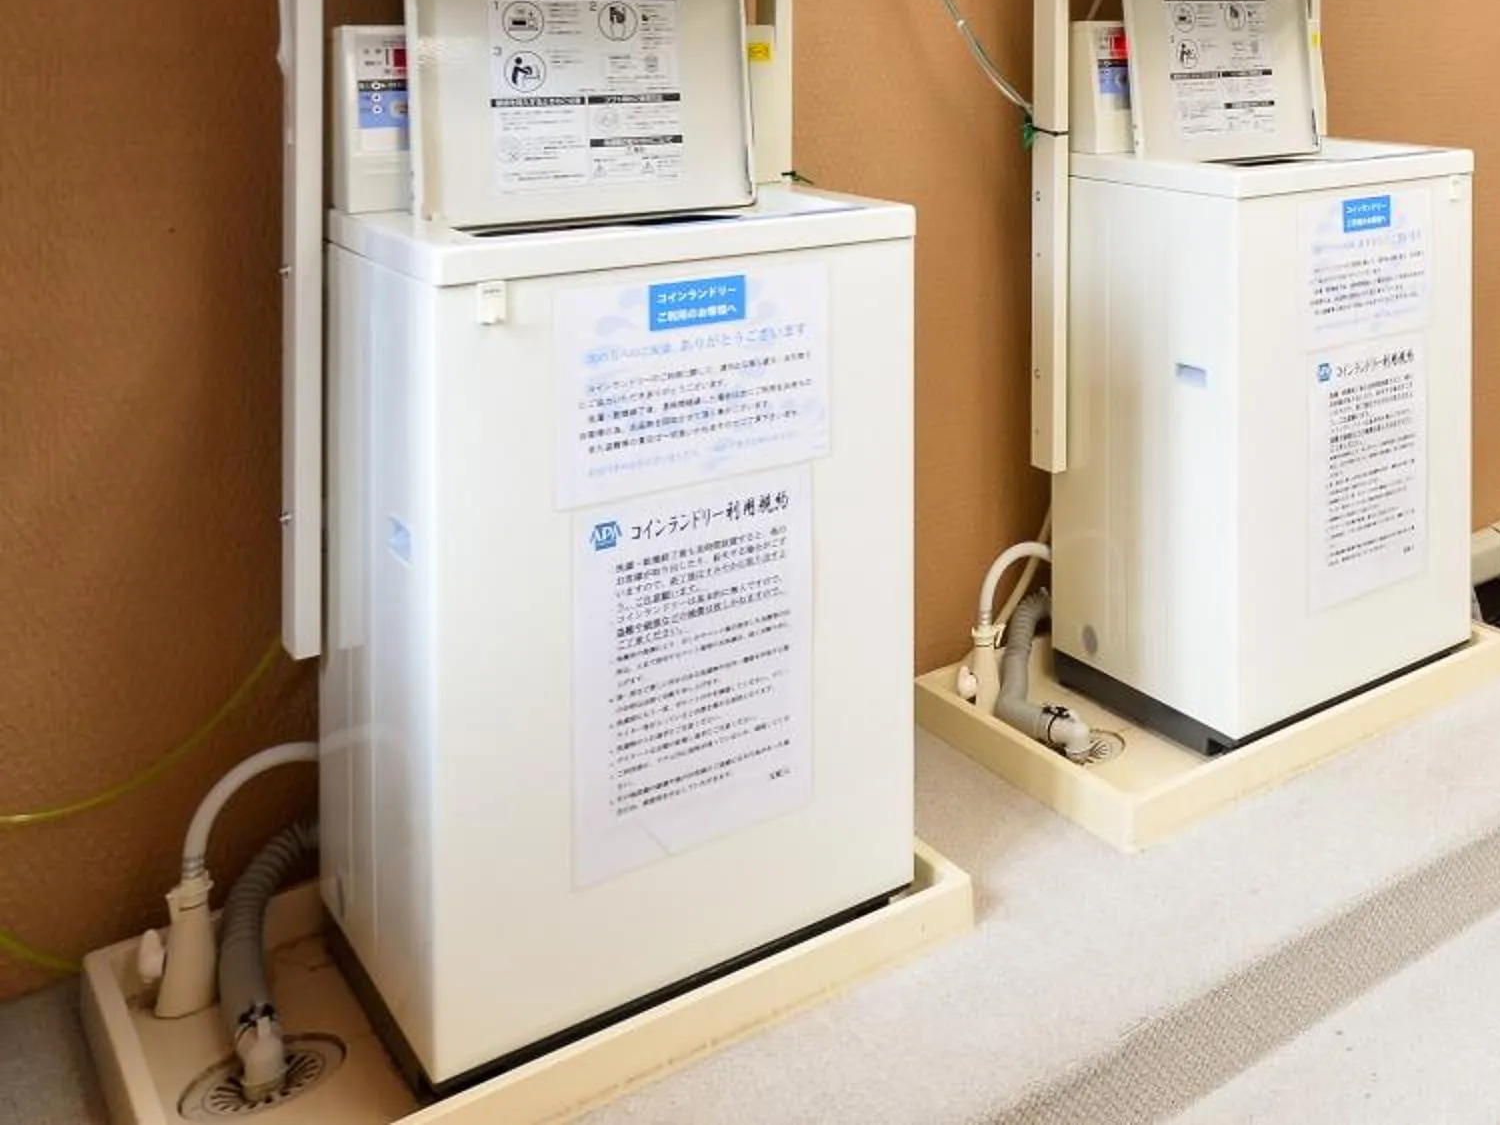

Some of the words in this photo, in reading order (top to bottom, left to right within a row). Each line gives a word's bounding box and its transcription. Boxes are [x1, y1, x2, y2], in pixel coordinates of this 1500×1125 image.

[657, 286, 737, 304] コインランドリー
